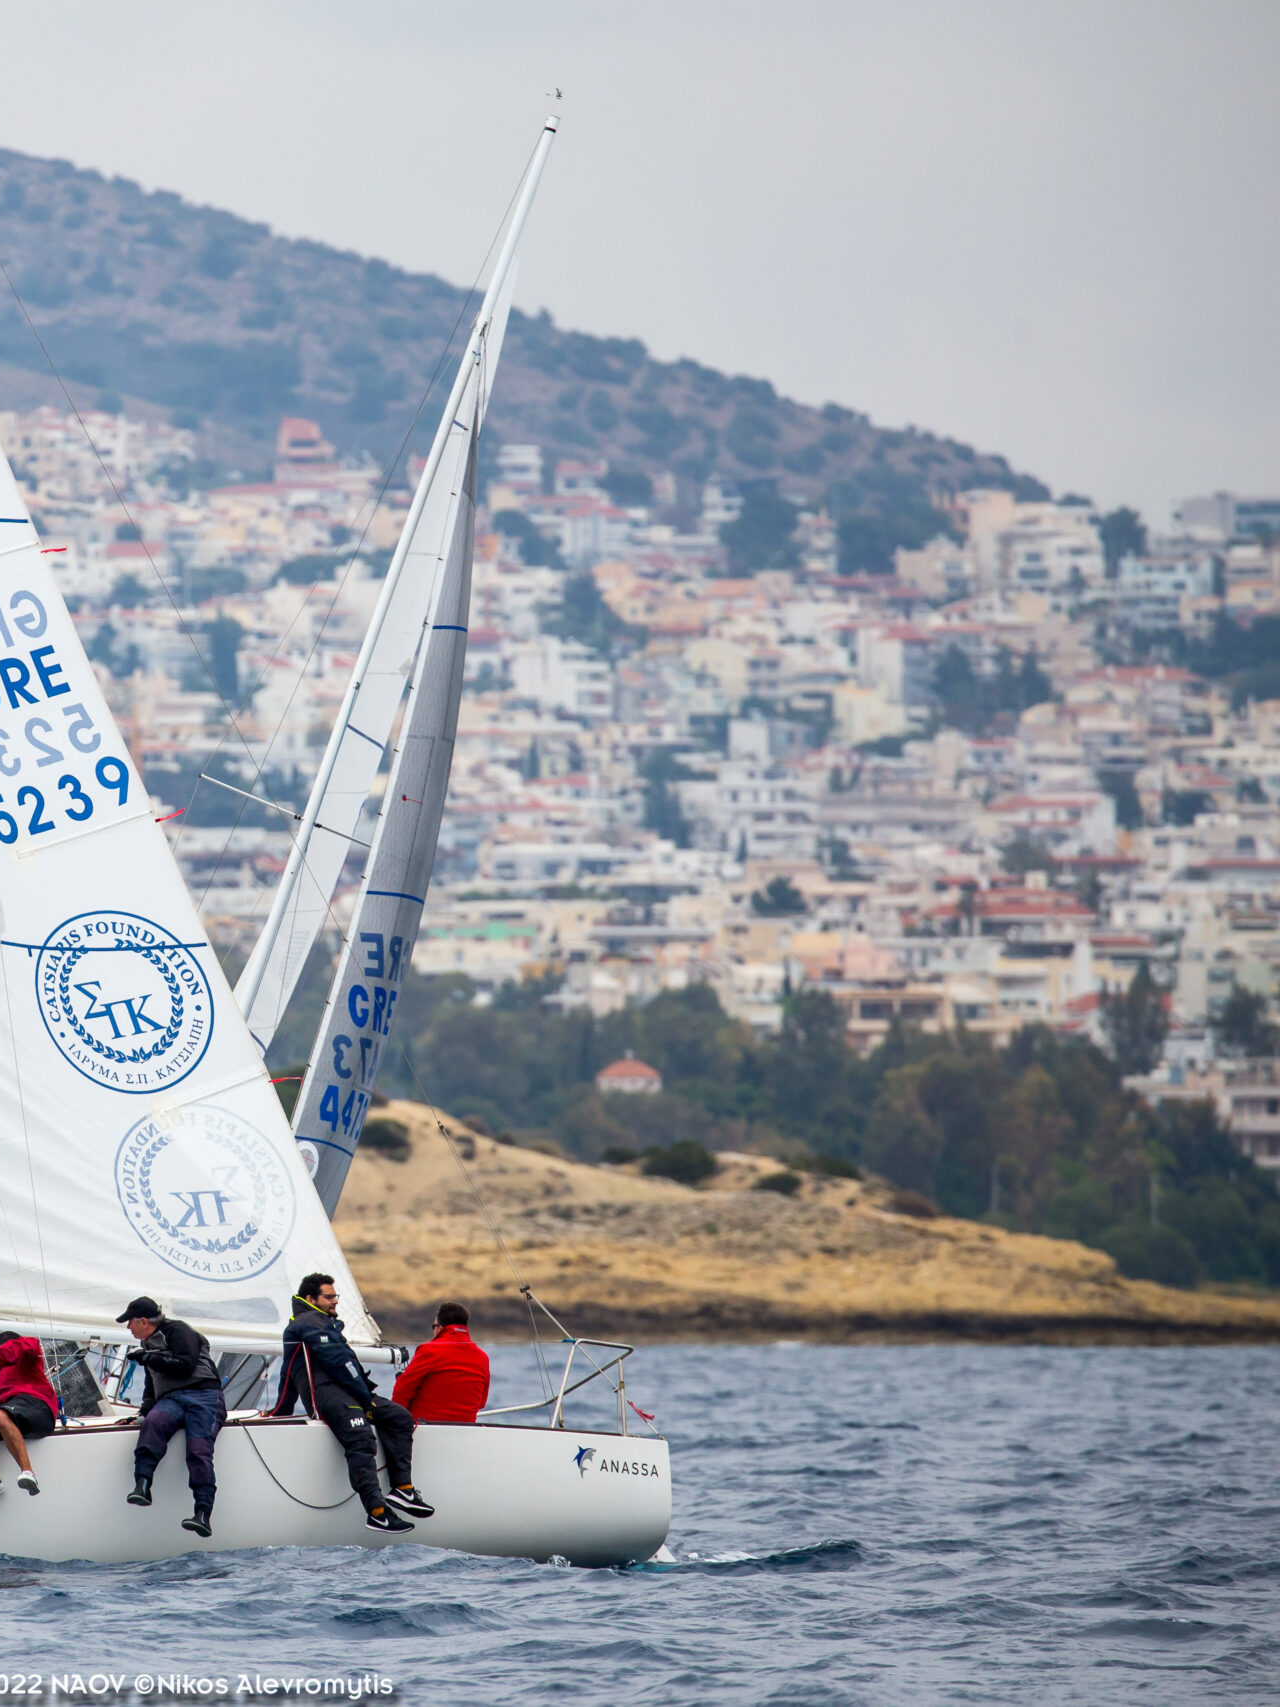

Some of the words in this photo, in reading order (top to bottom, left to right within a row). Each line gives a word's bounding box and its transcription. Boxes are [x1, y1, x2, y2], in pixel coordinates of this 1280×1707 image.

[82, 921, 204, 997] FOUNDATION
[347, 984, 398, 1036] GRE
[599, 1458, 659, 1478] ANASSA
